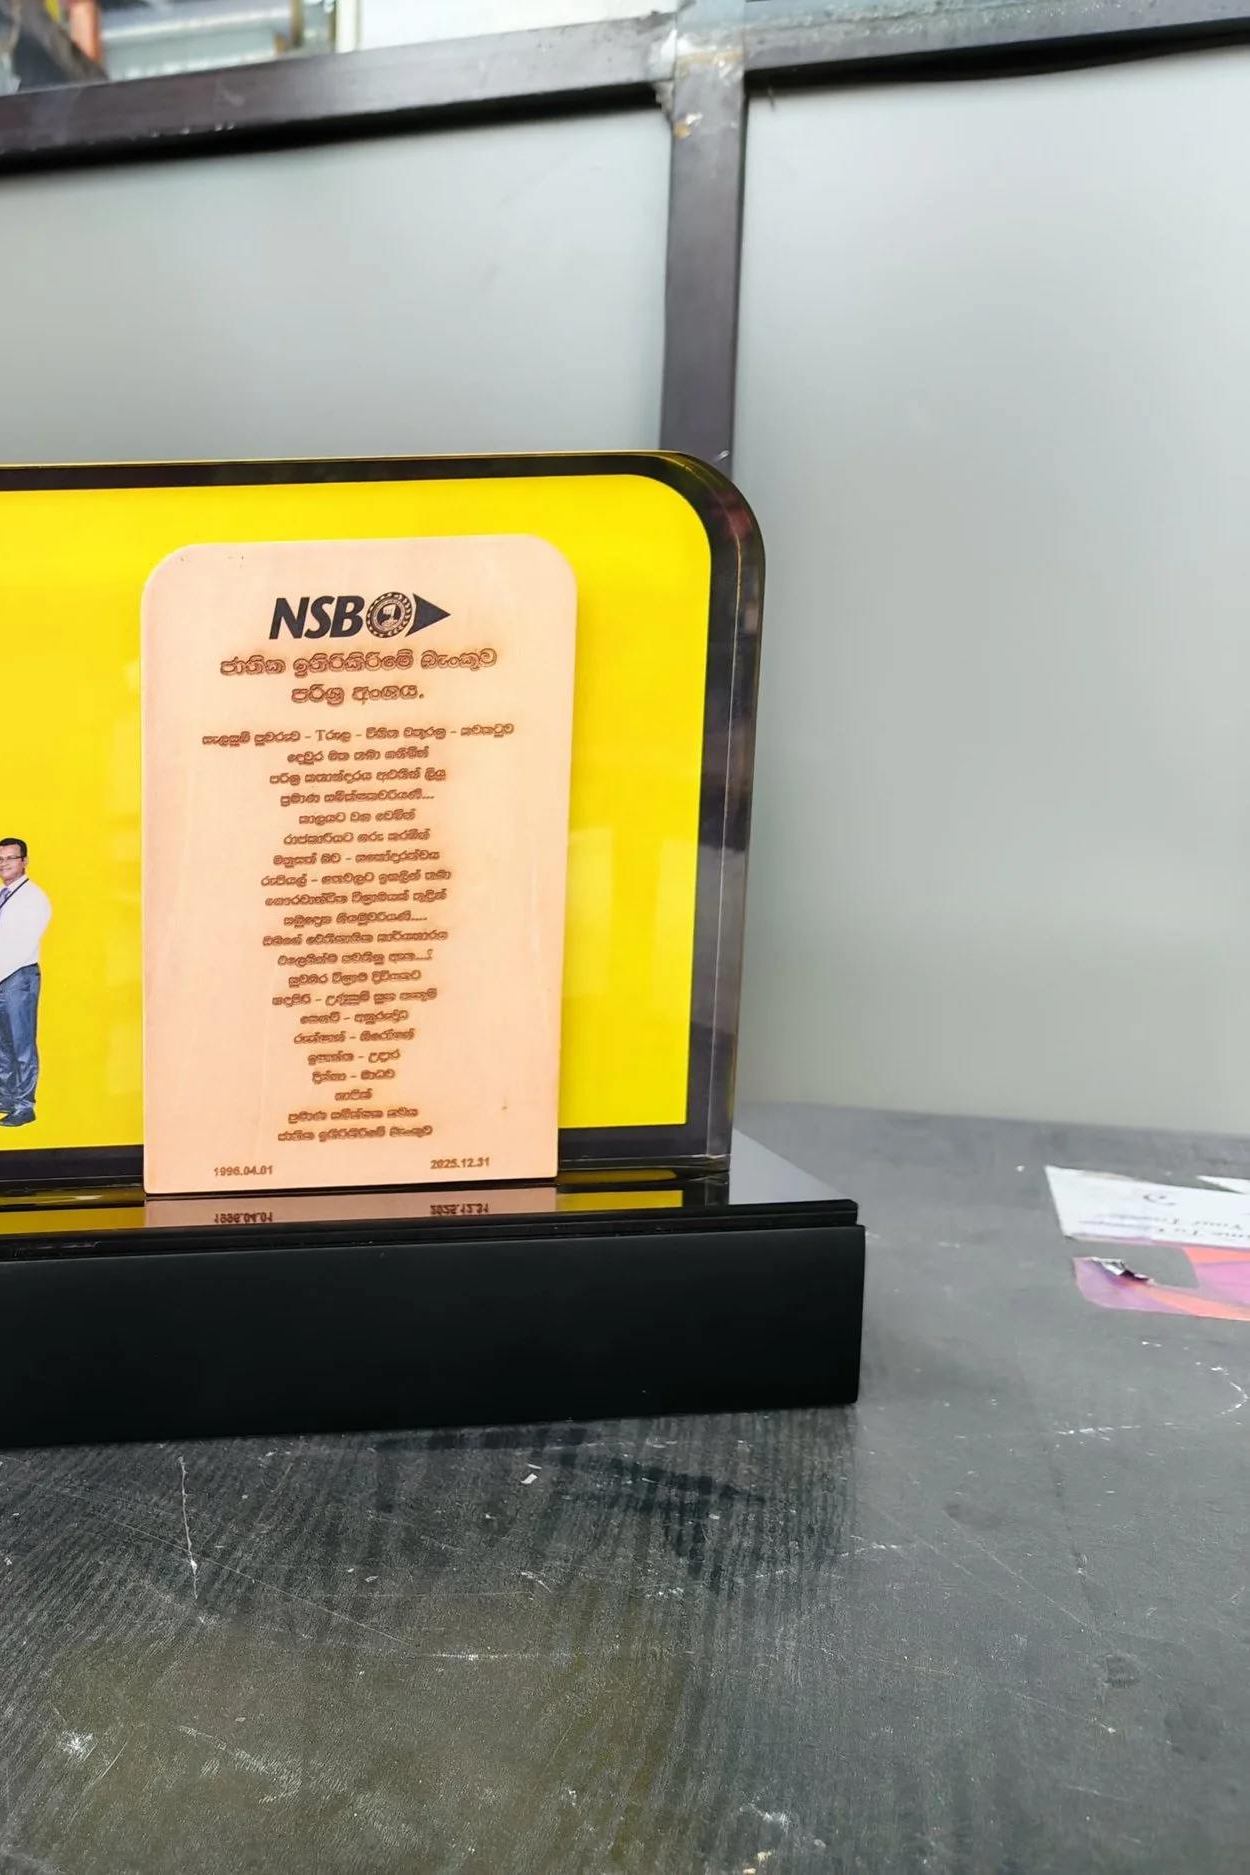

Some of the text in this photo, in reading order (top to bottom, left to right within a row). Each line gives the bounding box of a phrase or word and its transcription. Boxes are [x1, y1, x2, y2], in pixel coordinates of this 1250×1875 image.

[268, 595, 365, 640] NSB
[219, 654, 286, 677] ජාතික
[420, 647, 498, 671] බැංකුව
[298, 812, 346, 826] කාලයට
[283, 832, 354, 845] රාජකාරියට
[430, 1157, 490, 1169] 2025.12.31
